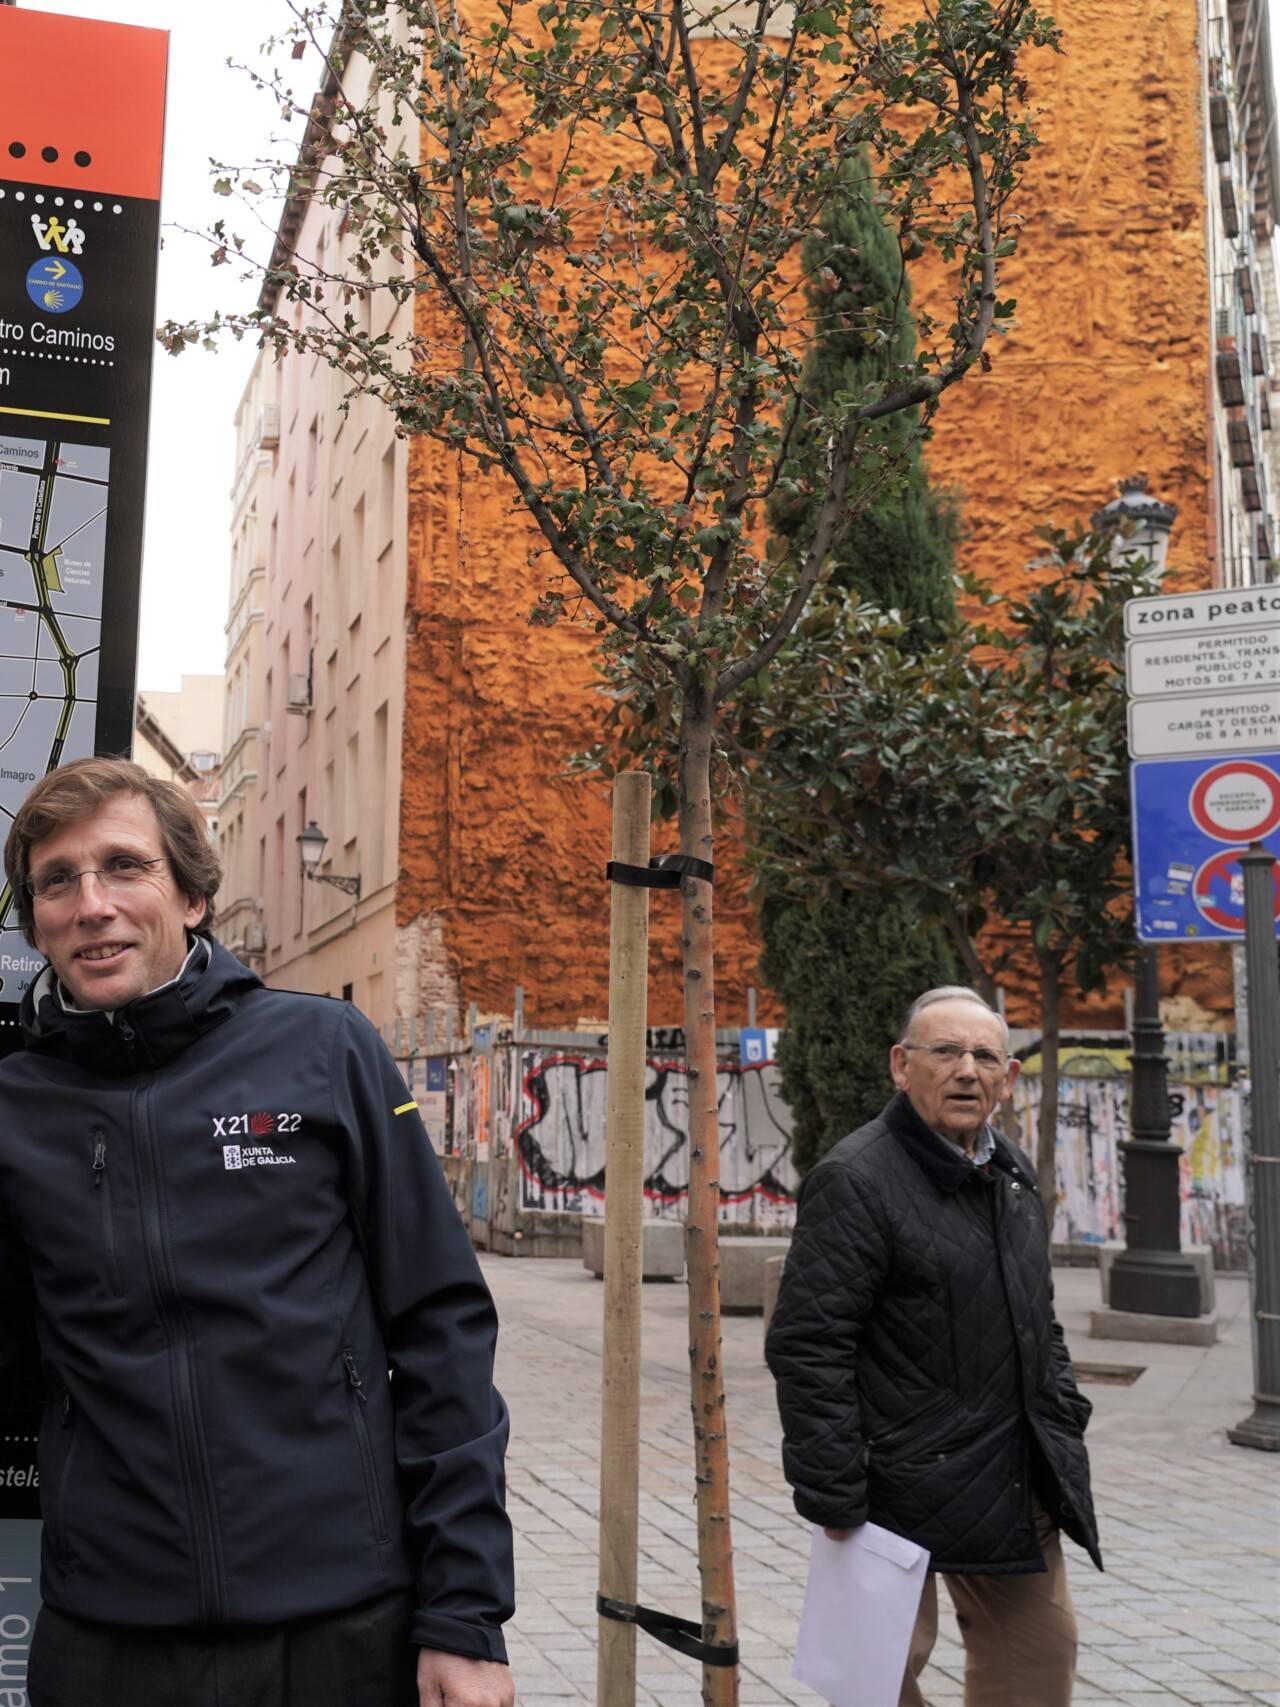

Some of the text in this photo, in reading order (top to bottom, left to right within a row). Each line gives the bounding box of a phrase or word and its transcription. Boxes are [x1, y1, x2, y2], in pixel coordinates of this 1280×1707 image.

[31, 322, 115, 352] Caminos
[1138, 595, 1280, 624] zona peato
[1198, 635, 1268, 649] PERMITIDO
[1237, 645, 1280, 658] TRANS
[1195, 659, 1266, 673] PUBLICO Y
[1165, 675, 1211, 688] MOTOS
[1218, 673, 1235, 684] DE
[1242, 672, 1249, 681] 7
[1254, 671, 1263, 680] A
[1200, 704, 1270, 717] PERMITIDO
[1168, 714, 1280, 732] CARGA Y DESCA
[1196, 731, 1212, 741] DE
[1219, 729, 1227, 739] 8
[1233, 728, 1243, 738] A
[1248, 727, 1258, 737] 11
[1, 954, 43, 972] Retiro
[212, 1112, 302, 1137] X21 22
[241, 1146, 274, 1157] XUNTA
[242, 1156, 296, 1167] DE GALICIA
